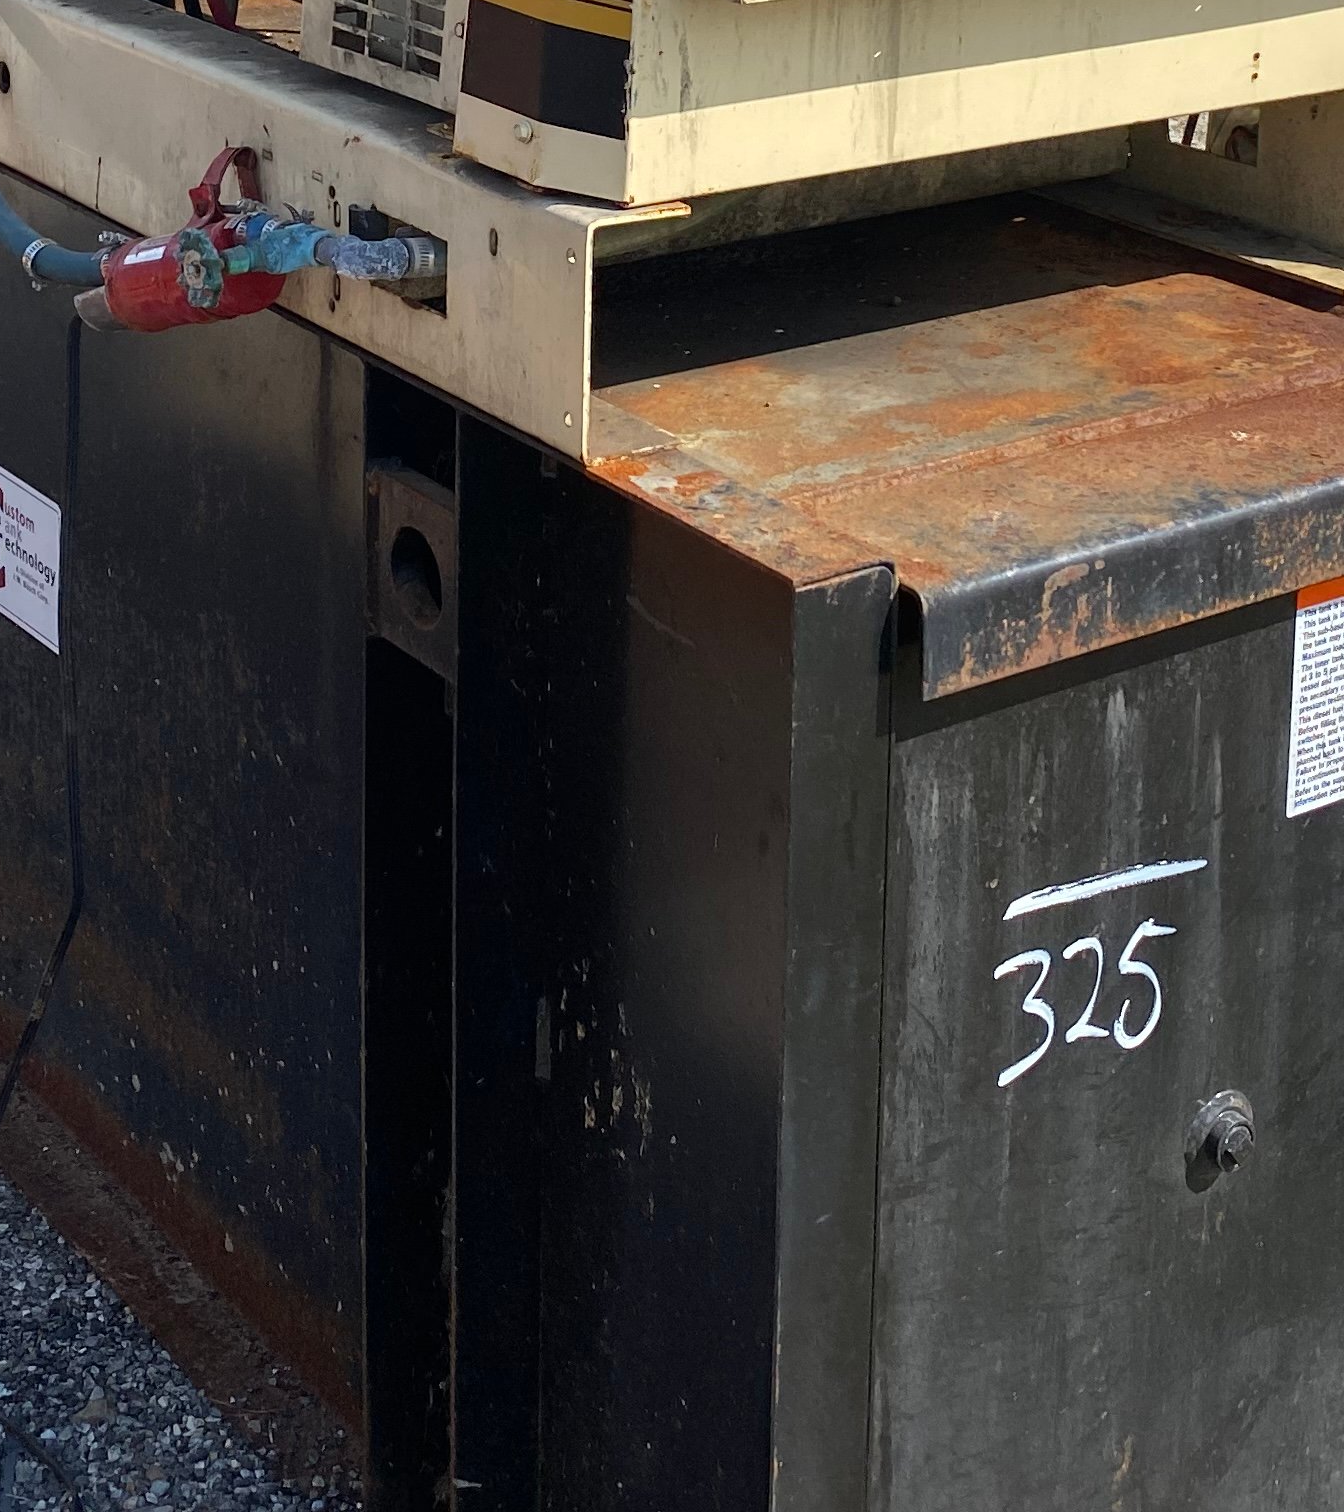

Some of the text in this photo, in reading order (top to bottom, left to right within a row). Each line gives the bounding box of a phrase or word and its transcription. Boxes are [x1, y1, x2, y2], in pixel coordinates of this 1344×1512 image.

[1304, 620, 1316, 628] This
[1318, 615, 1331, 624] tank
[1303, 631, 1316, 639] This
[1302, 664, 1312, 672] The
[1299, 716, 1311, 725] This
[993, 918, 1178, 1087] 325
